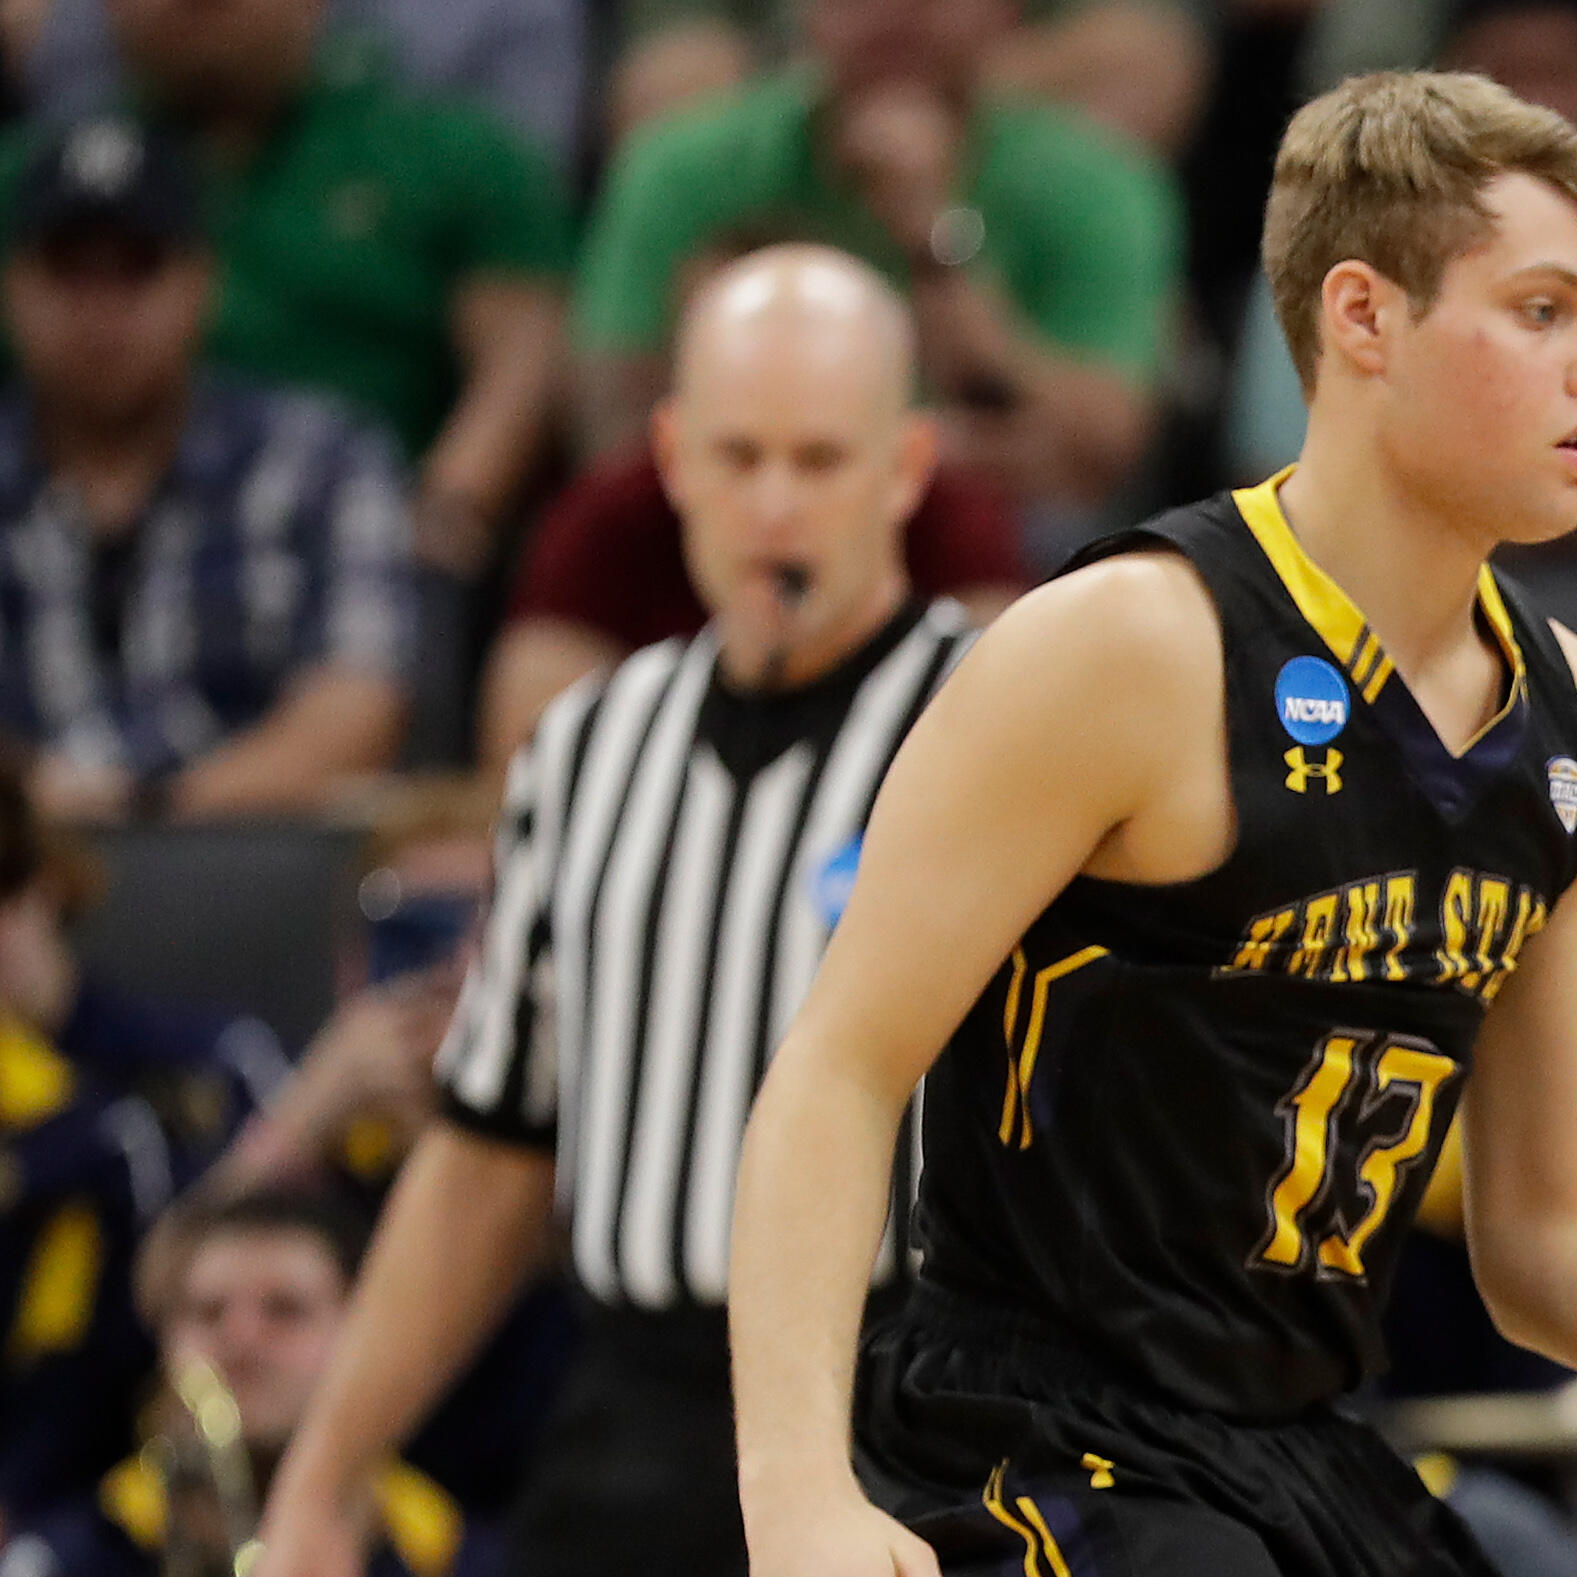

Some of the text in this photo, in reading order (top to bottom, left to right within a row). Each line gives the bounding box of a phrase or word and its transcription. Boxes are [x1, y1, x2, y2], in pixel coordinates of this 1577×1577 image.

[1284, 696, 1346, 725] NCAA
[1211, 868, 1418, 983] KENT
[1244, 1026, 1462, 1287] 13
